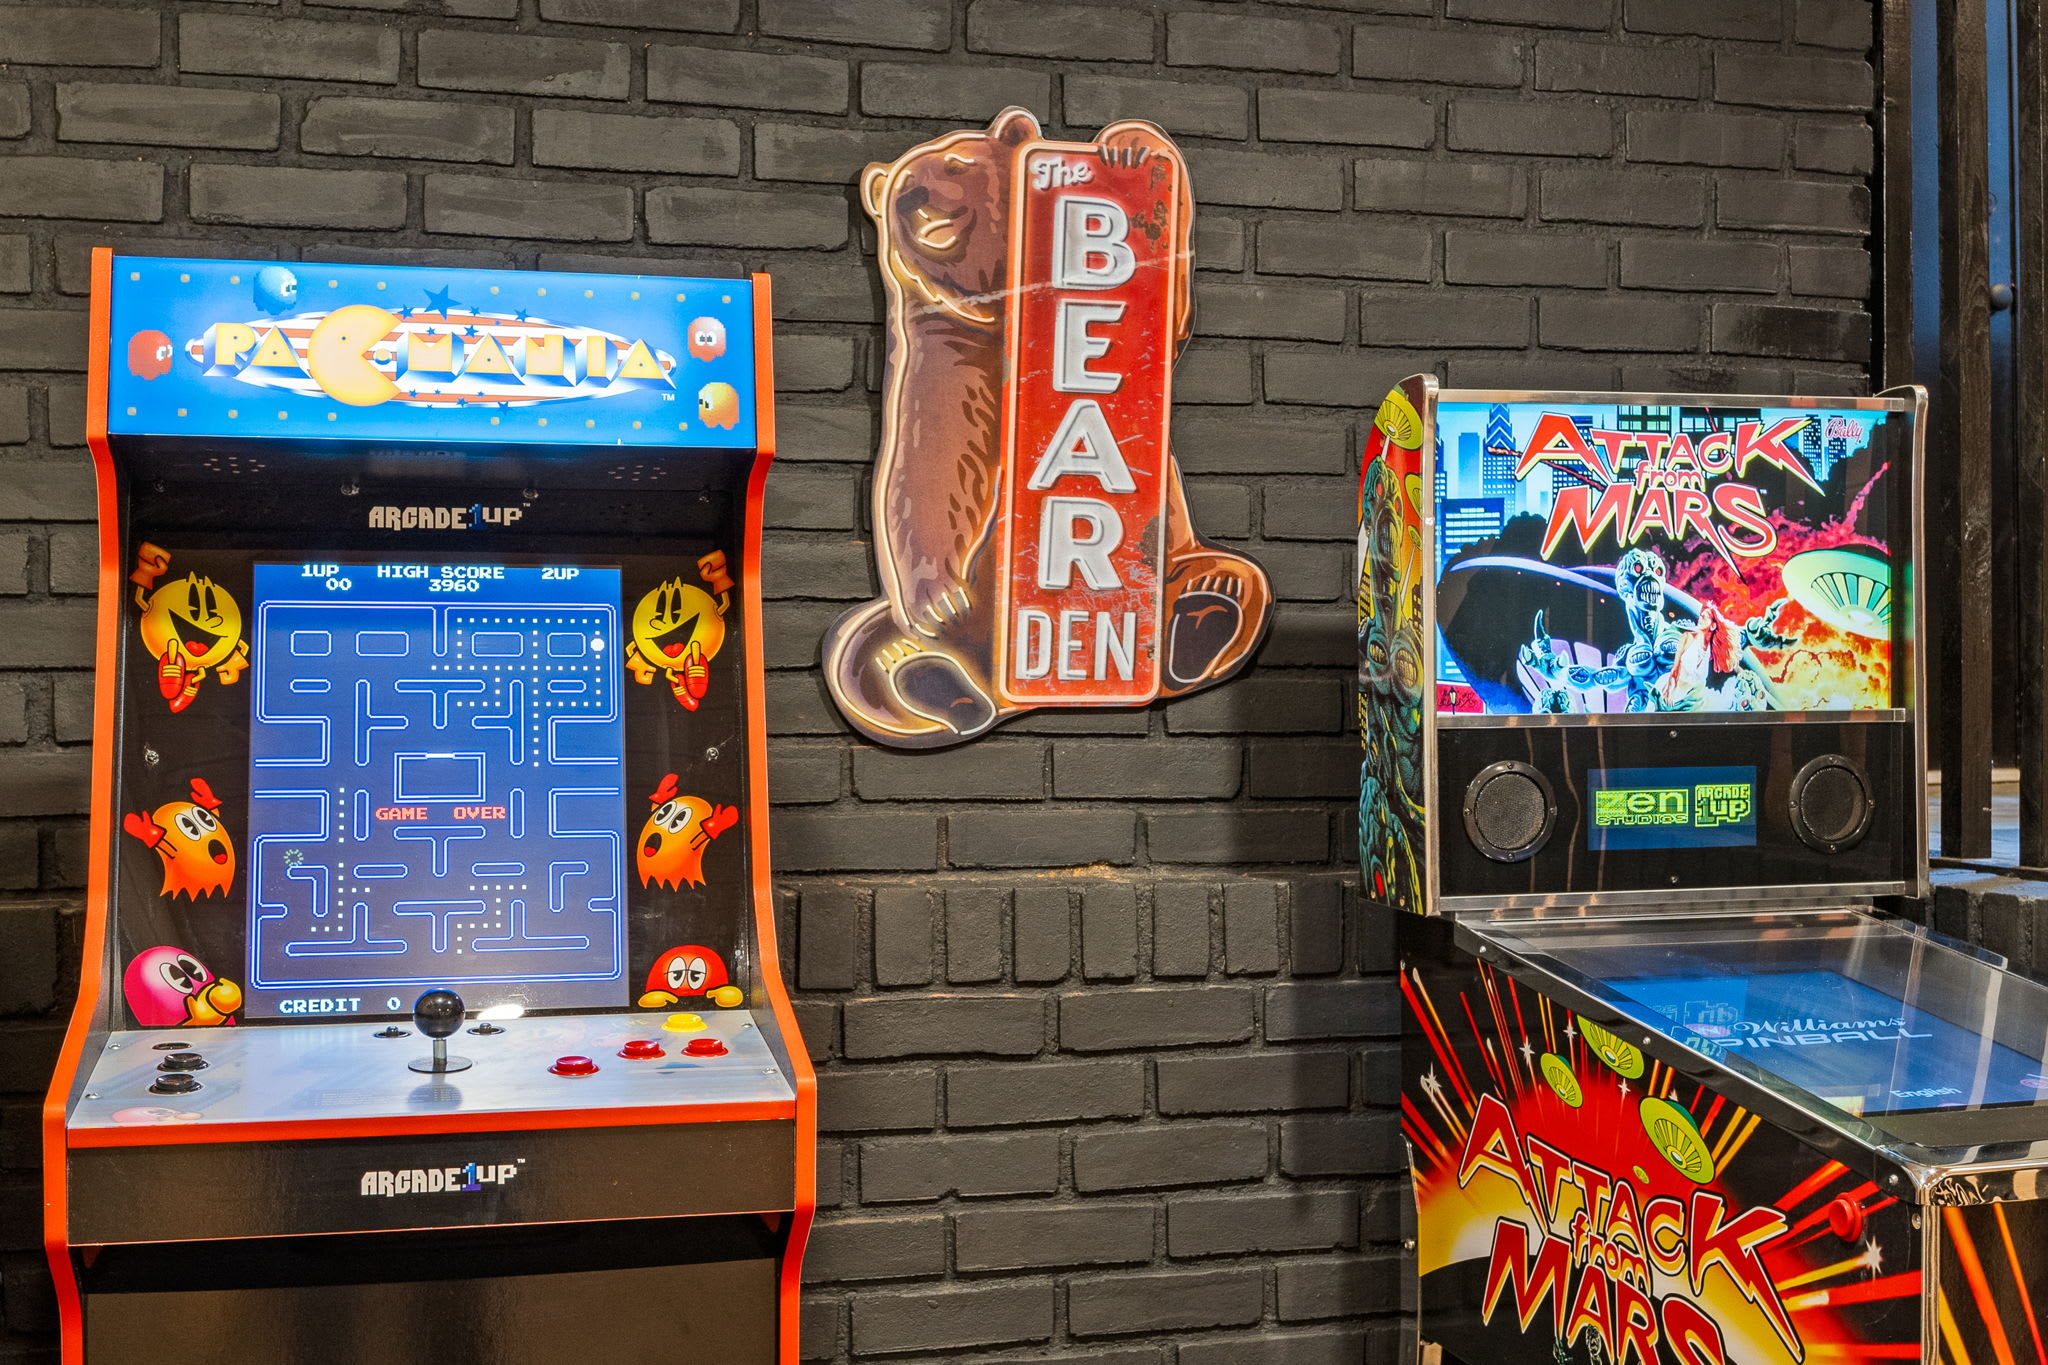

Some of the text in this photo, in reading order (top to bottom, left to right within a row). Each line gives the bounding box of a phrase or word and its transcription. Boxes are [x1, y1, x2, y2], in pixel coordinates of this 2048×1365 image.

[1030, 156, 1092, 191] The
[1027, 195, 1136, 592] BEAR
[1825, 417, 1864, 442] Bally
[1515, 411, 1826, 496] ATTACK
[1635, 461, 1706, 491] from
[1541, 481, 1778, 584] MARS
[301, 564, 340, 577] 1UP
[377, 565, 506, 579] HIGH SCORE
[541, 567, 580, 580] 2UP
[428, 579, 480, 593] 3960
[1015, 610, 1136, 682] DEN
[375, 806, 507, 821] GAME OVER
[1597, 814, 1688, 826] STUDIOS
[279, 996, 401, 1014] CREDIT 0
[1733, 1016, 1907, 1034] Williams
[1712, 1028, 1933, 1048] PINBALL
[1889, 1085, 1963, 1099] English
[1457, 1092, 1806, 1365] ATTACK
[1571, 1209, 1652, 1298] from
